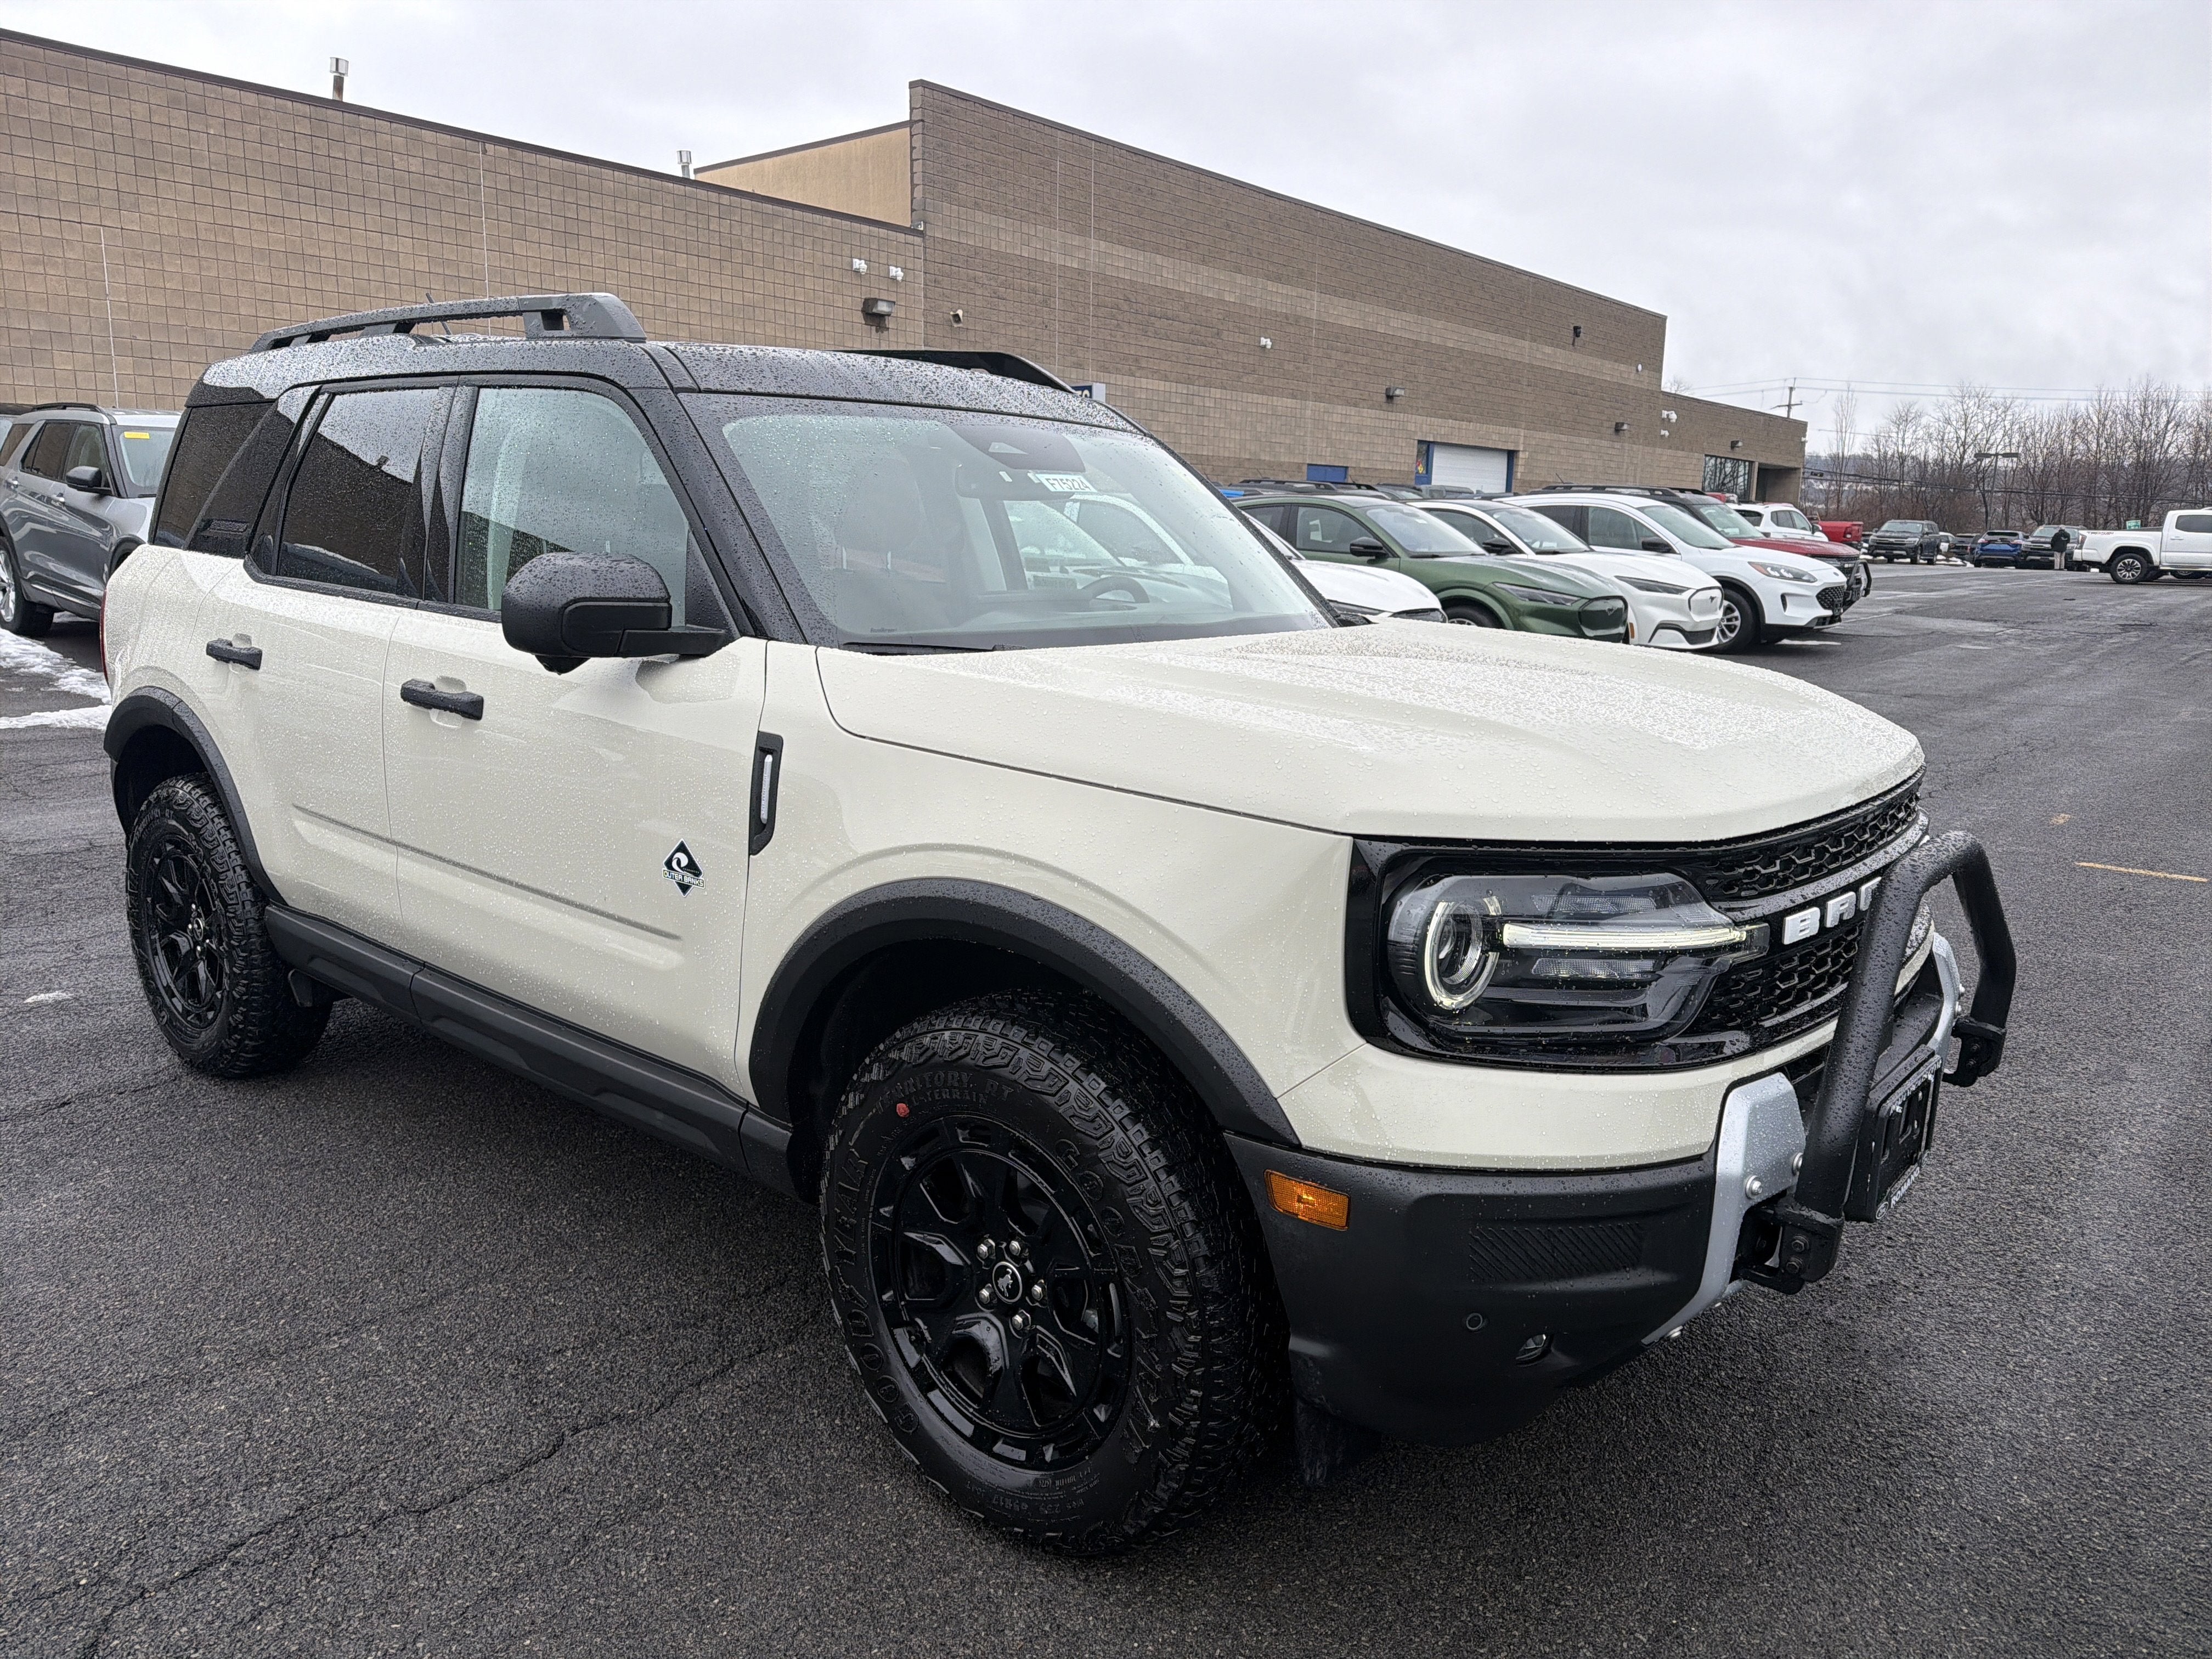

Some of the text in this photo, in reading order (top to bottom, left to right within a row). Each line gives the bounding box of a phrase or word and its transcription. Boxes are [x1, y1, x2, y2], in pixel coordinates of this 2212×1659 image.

[1045, 477, 1091, 491] F75224
[664, 871, 683, 882] OUTER
[684, 876, 703, 887] BANKS
[1891, 1167, 1920, 1209] ROMANO
[833, 1148, 919, 1434] GOODYEAR
